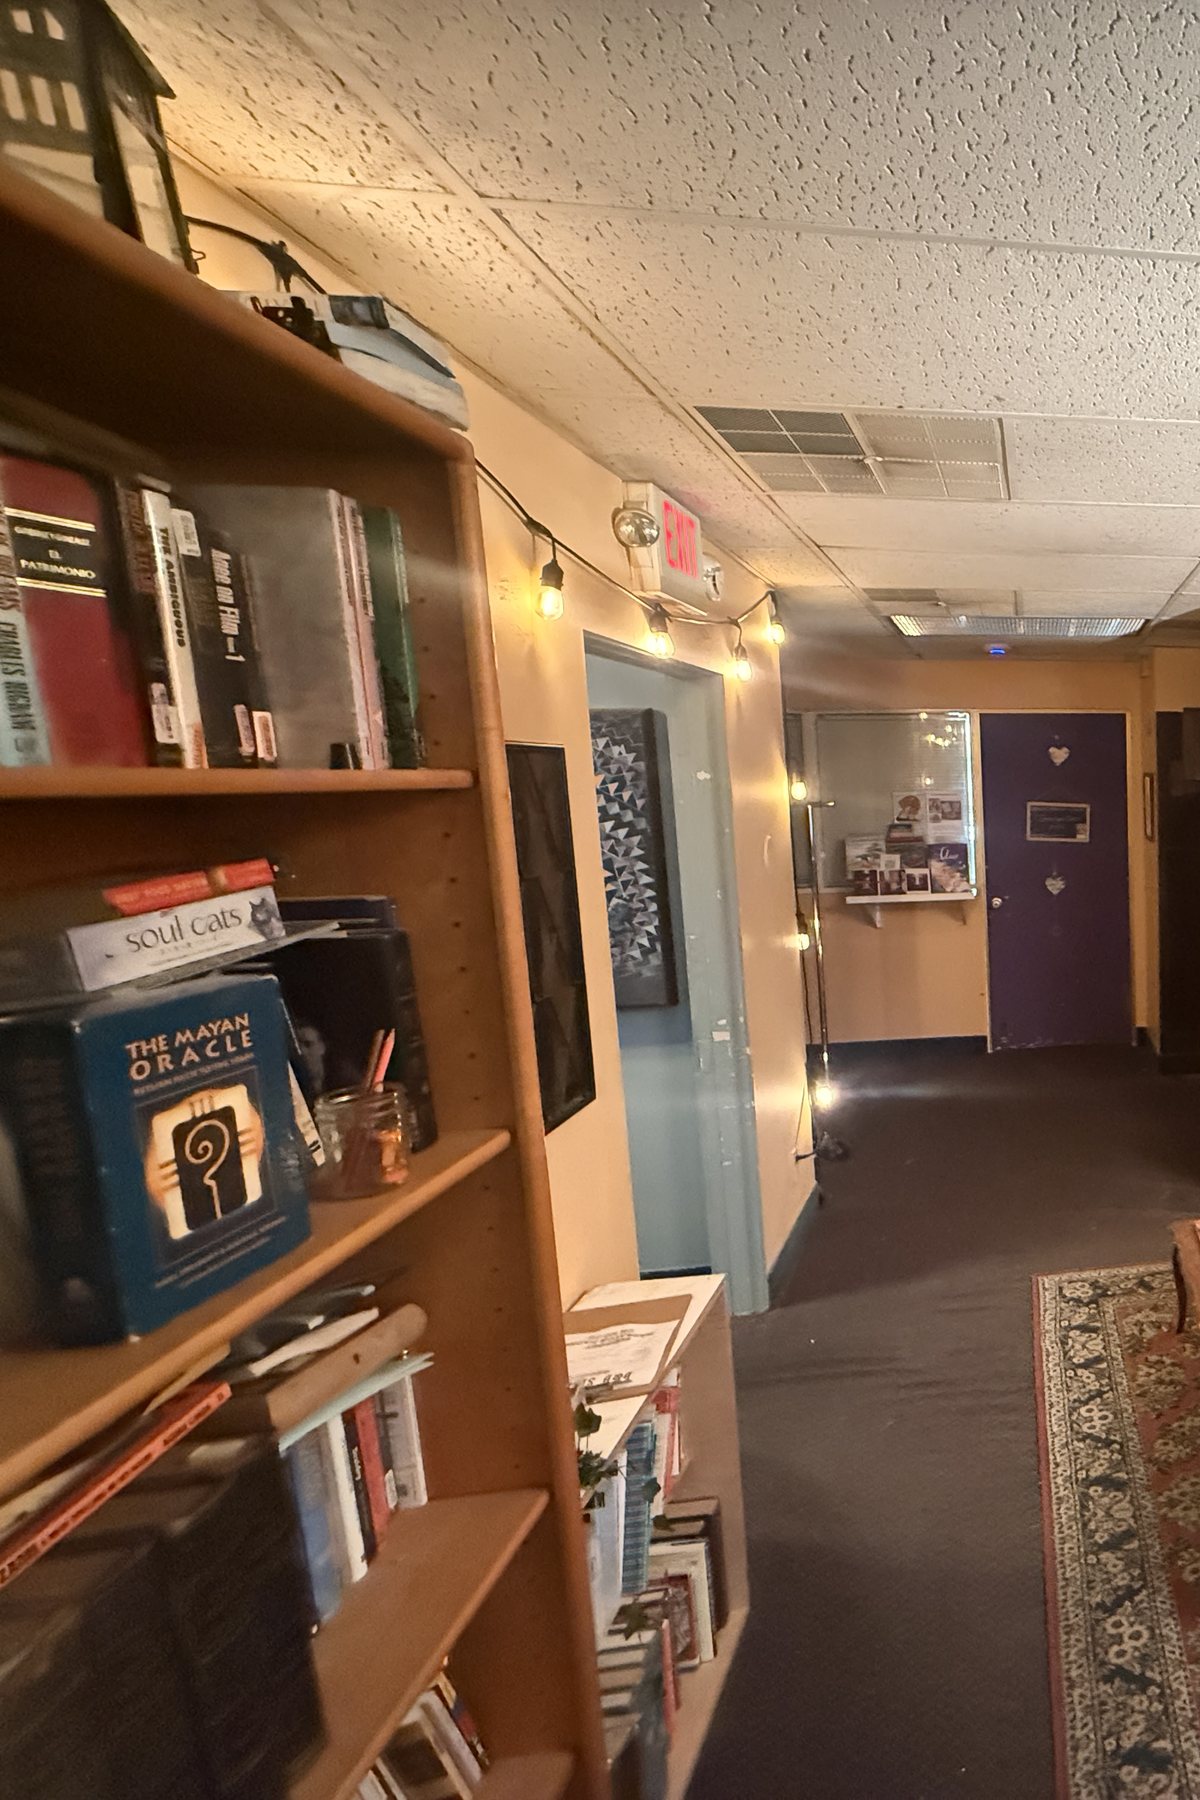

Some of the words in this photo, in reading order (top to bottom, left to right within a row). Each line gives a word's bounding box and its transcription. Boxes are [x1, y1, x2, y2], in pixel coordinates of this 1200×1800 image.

[159, 527, 172, 555] THE
[20, 559, 97, 579] PATRIMONIO
[165, 559, 187, 648] AMBIGUOUS
[218, 606, 241, 636] Film
[0, 621, 26, 676] CHARLES
[126, 915, 185, 953] soul
[191, 908, 243, 936] cats
[125, 1034, 169, 1059] THE
[174, 1012, 250, 1048] MAYAN
[129, 1029, 254, 1081] ORACLE
